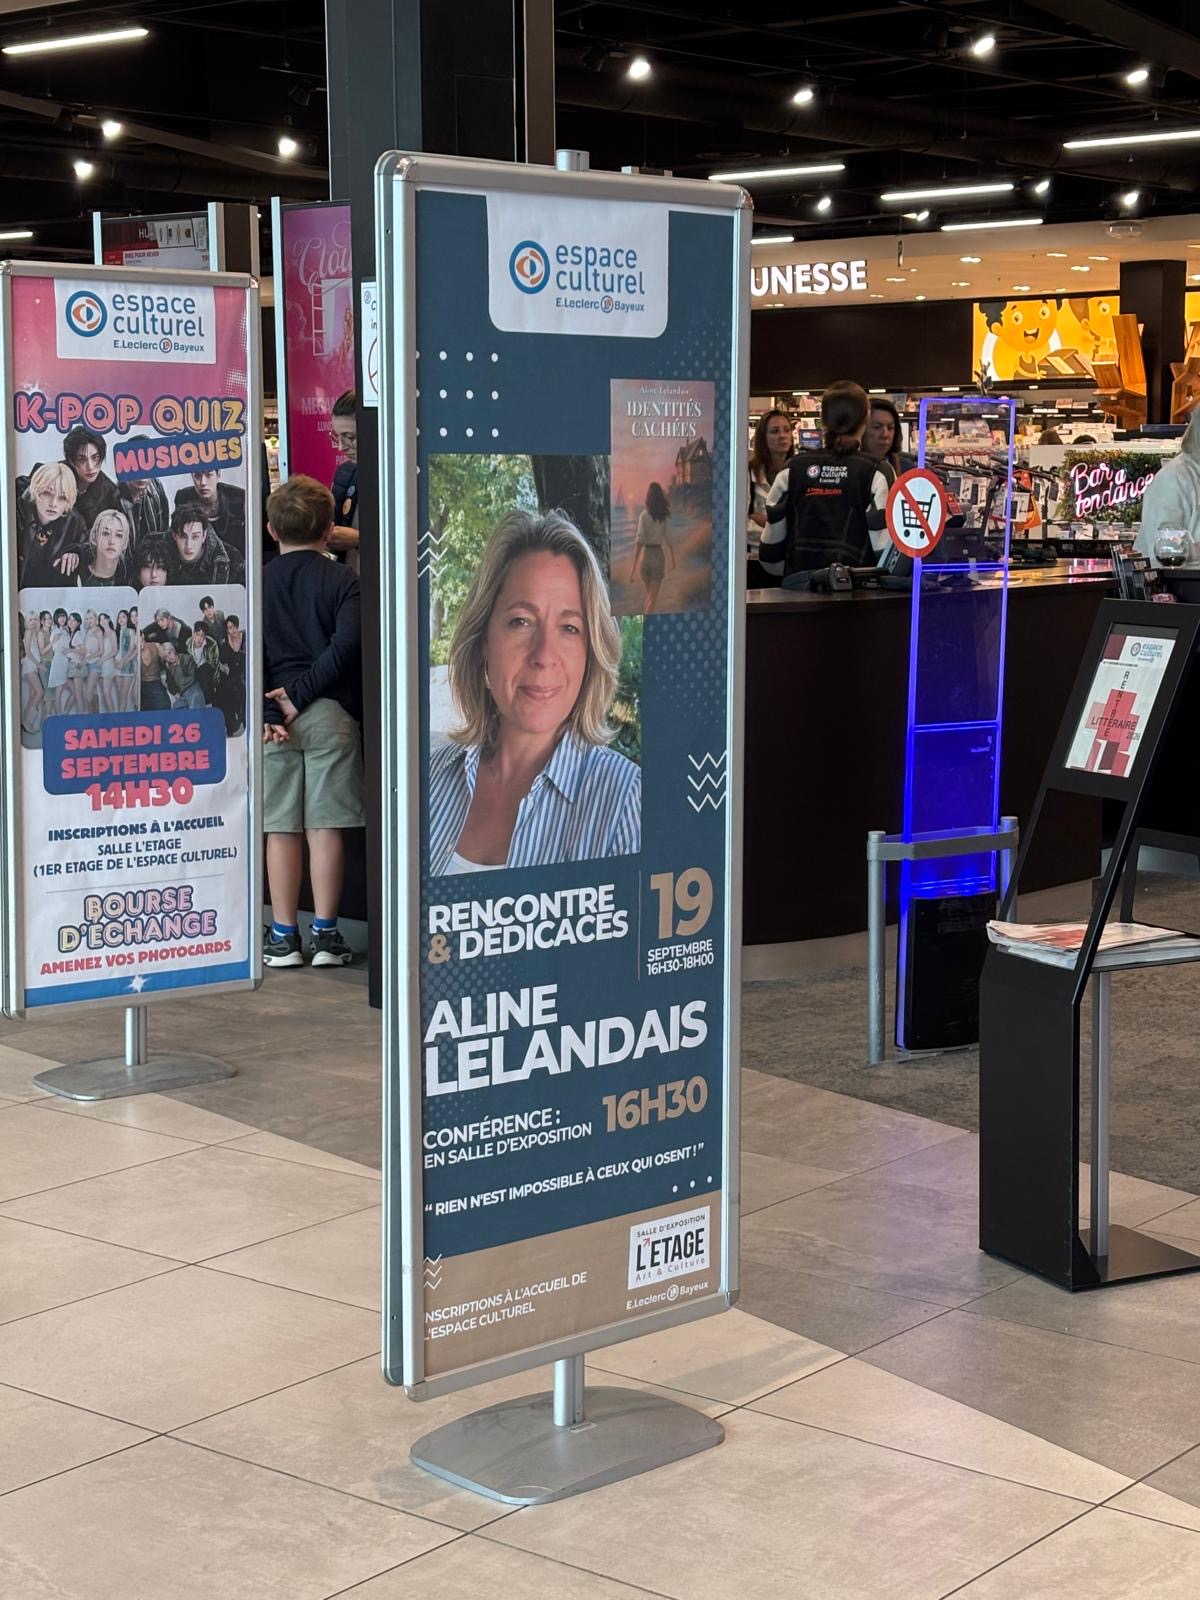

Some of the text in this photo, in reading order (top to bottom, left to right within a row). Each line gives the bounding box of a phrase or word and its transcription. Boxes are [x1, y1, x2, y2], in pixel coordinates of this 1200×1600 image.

[556, 244, 637, 268] espace
[556, 267, 645, 295] culturel
[112, 293, 196, 315] espace
[556, 297, 600, 310] E.Leclerc
[614, 300, 645, 312] Bayeux
[114, 314, 205, 337] culturel
[114, 340, 158, 350] E.Leclerc
[174, 342, 204, 353] Bayeux
[14, 392, 247, 436] K-POP QUIZ
[627, 398, 702, 417] IDENTITÉS
[631, 418, 697, 437] CACHÉES
[116, 436, 242, 473] MUSIQUES
[1071, 462, 1113, 494] Bar
[64, 723, 201, 750] SAMEDI 26
[61, 750, 210, 779] SEPTEMBRE
[85, 776, 194, 812] 14H30
[48, 816, 224, 842] INSCRIPTIONS À L'ACCUEIL
[98, 838, 182, 856] SALLE L'ETAGE
[34, 846, 238, 878] (1ER ETAGE DE L'ESPACE CULTUREL)
[84, 886, 194, 922] BOURSE
[428, 866, 714, 940] RENCONTRE 19
[428, 910, 628, 964] & DEDICACES
[647, 939, 713, 962] SEPTEMBRE
[40, 940, 232, 975] AMENEZ VOS PHOTOCARDS
[646, 952, 714, 976] 16H30-18H00
[424, 984, 558, 1044] ALINE
[426, 1000, 708, 1097] LELANDAIS
[602, 1075, 708, 1133] 16H30
[422, 1108, 552, 1150] CONFÉRENCE
[424, 1122, 592, 1169] EN SALLE D'EXPOSITION
[435, 1197, 468, 1216] RIEN
[470, 1188, 506, 1208] N'EST
[508, 1172, 584, 1200] IMPOSSIBLE
[586, 1166, 596, 1182] À
[596, 1161, 630, 1180] CEUX
[632, 1156, 652, 1175] QUI
[654, 1146, 692, 1167] OSENT
[636, 1214, 706, 1238] SALLE D'EXPOSITION
[636, 1258, 706, 1282] Art & Culture
[504, 1289, 512, 1302] À
[515, 1278, 570, 1300] L'ACCUEIL
[572, 1272, 588, 1286] DE
[626, 1292, 666, 1310] E.Leclerc
[680, 1281, 709, 1296] Bayeux
[424, 1301, 536, 1341] 'ESPACE CULTUREL
